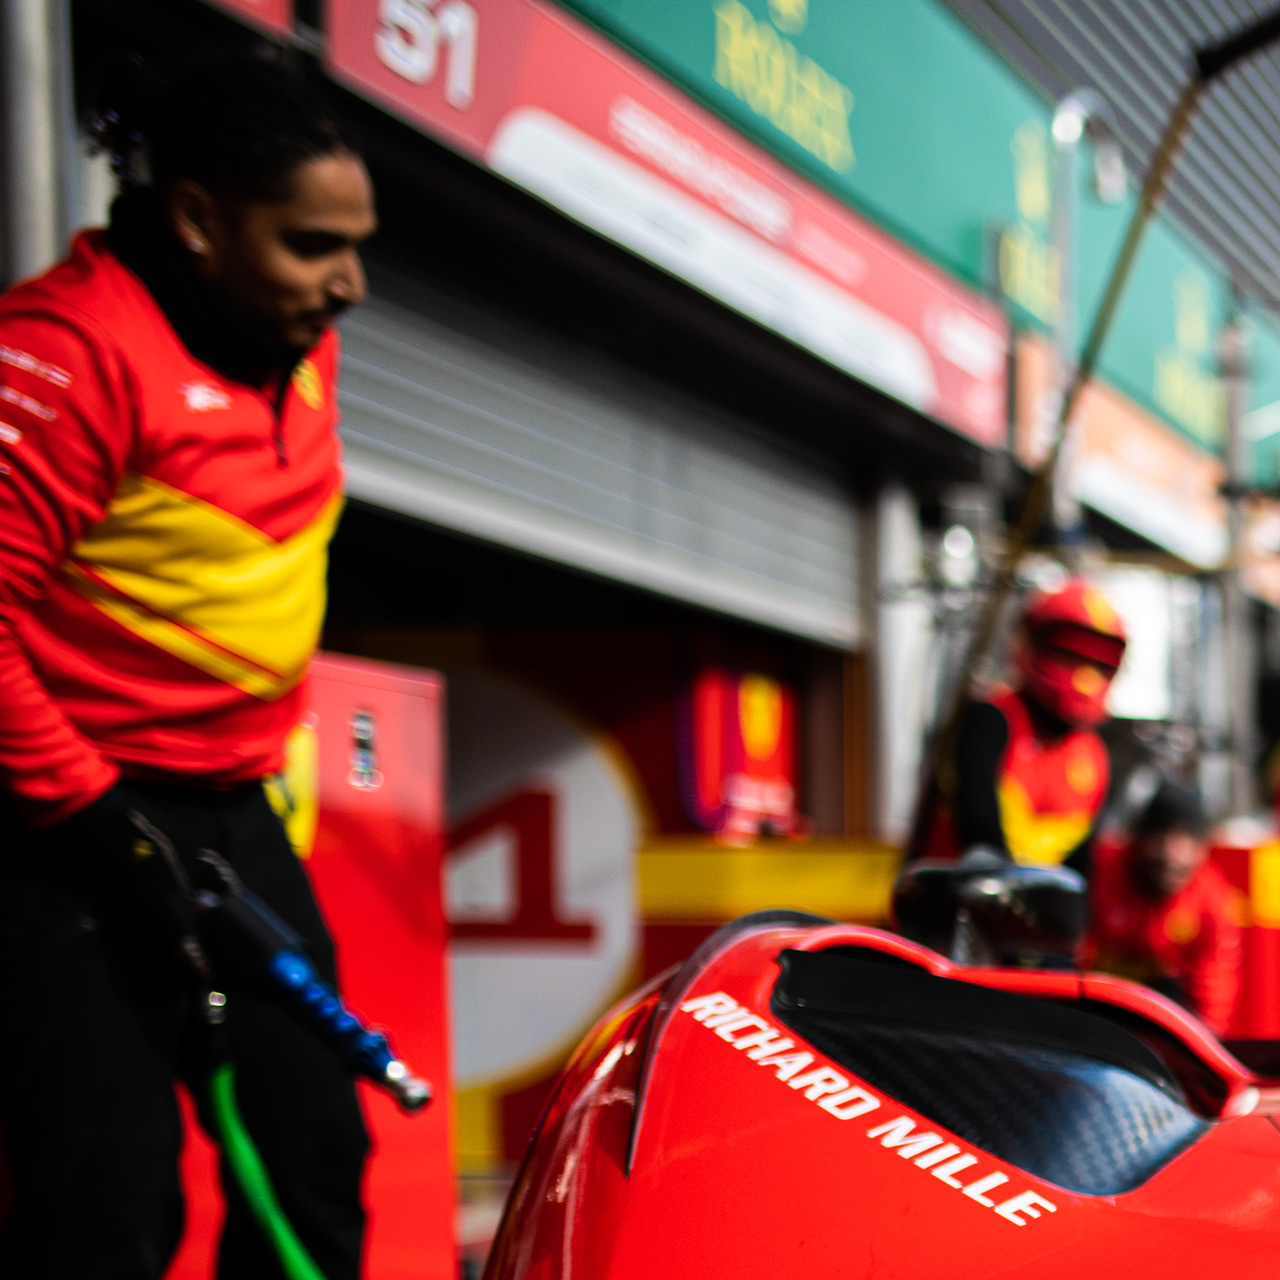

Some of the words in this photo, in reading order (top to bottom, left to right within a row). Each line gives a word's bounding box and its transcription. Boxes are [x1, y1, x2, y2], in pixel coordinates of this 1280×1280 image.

[375, 0, 478, 109] 51
[681, 991, 881, 1121] RICHARD
[866, 1115, 1057, 1227] MILLE
